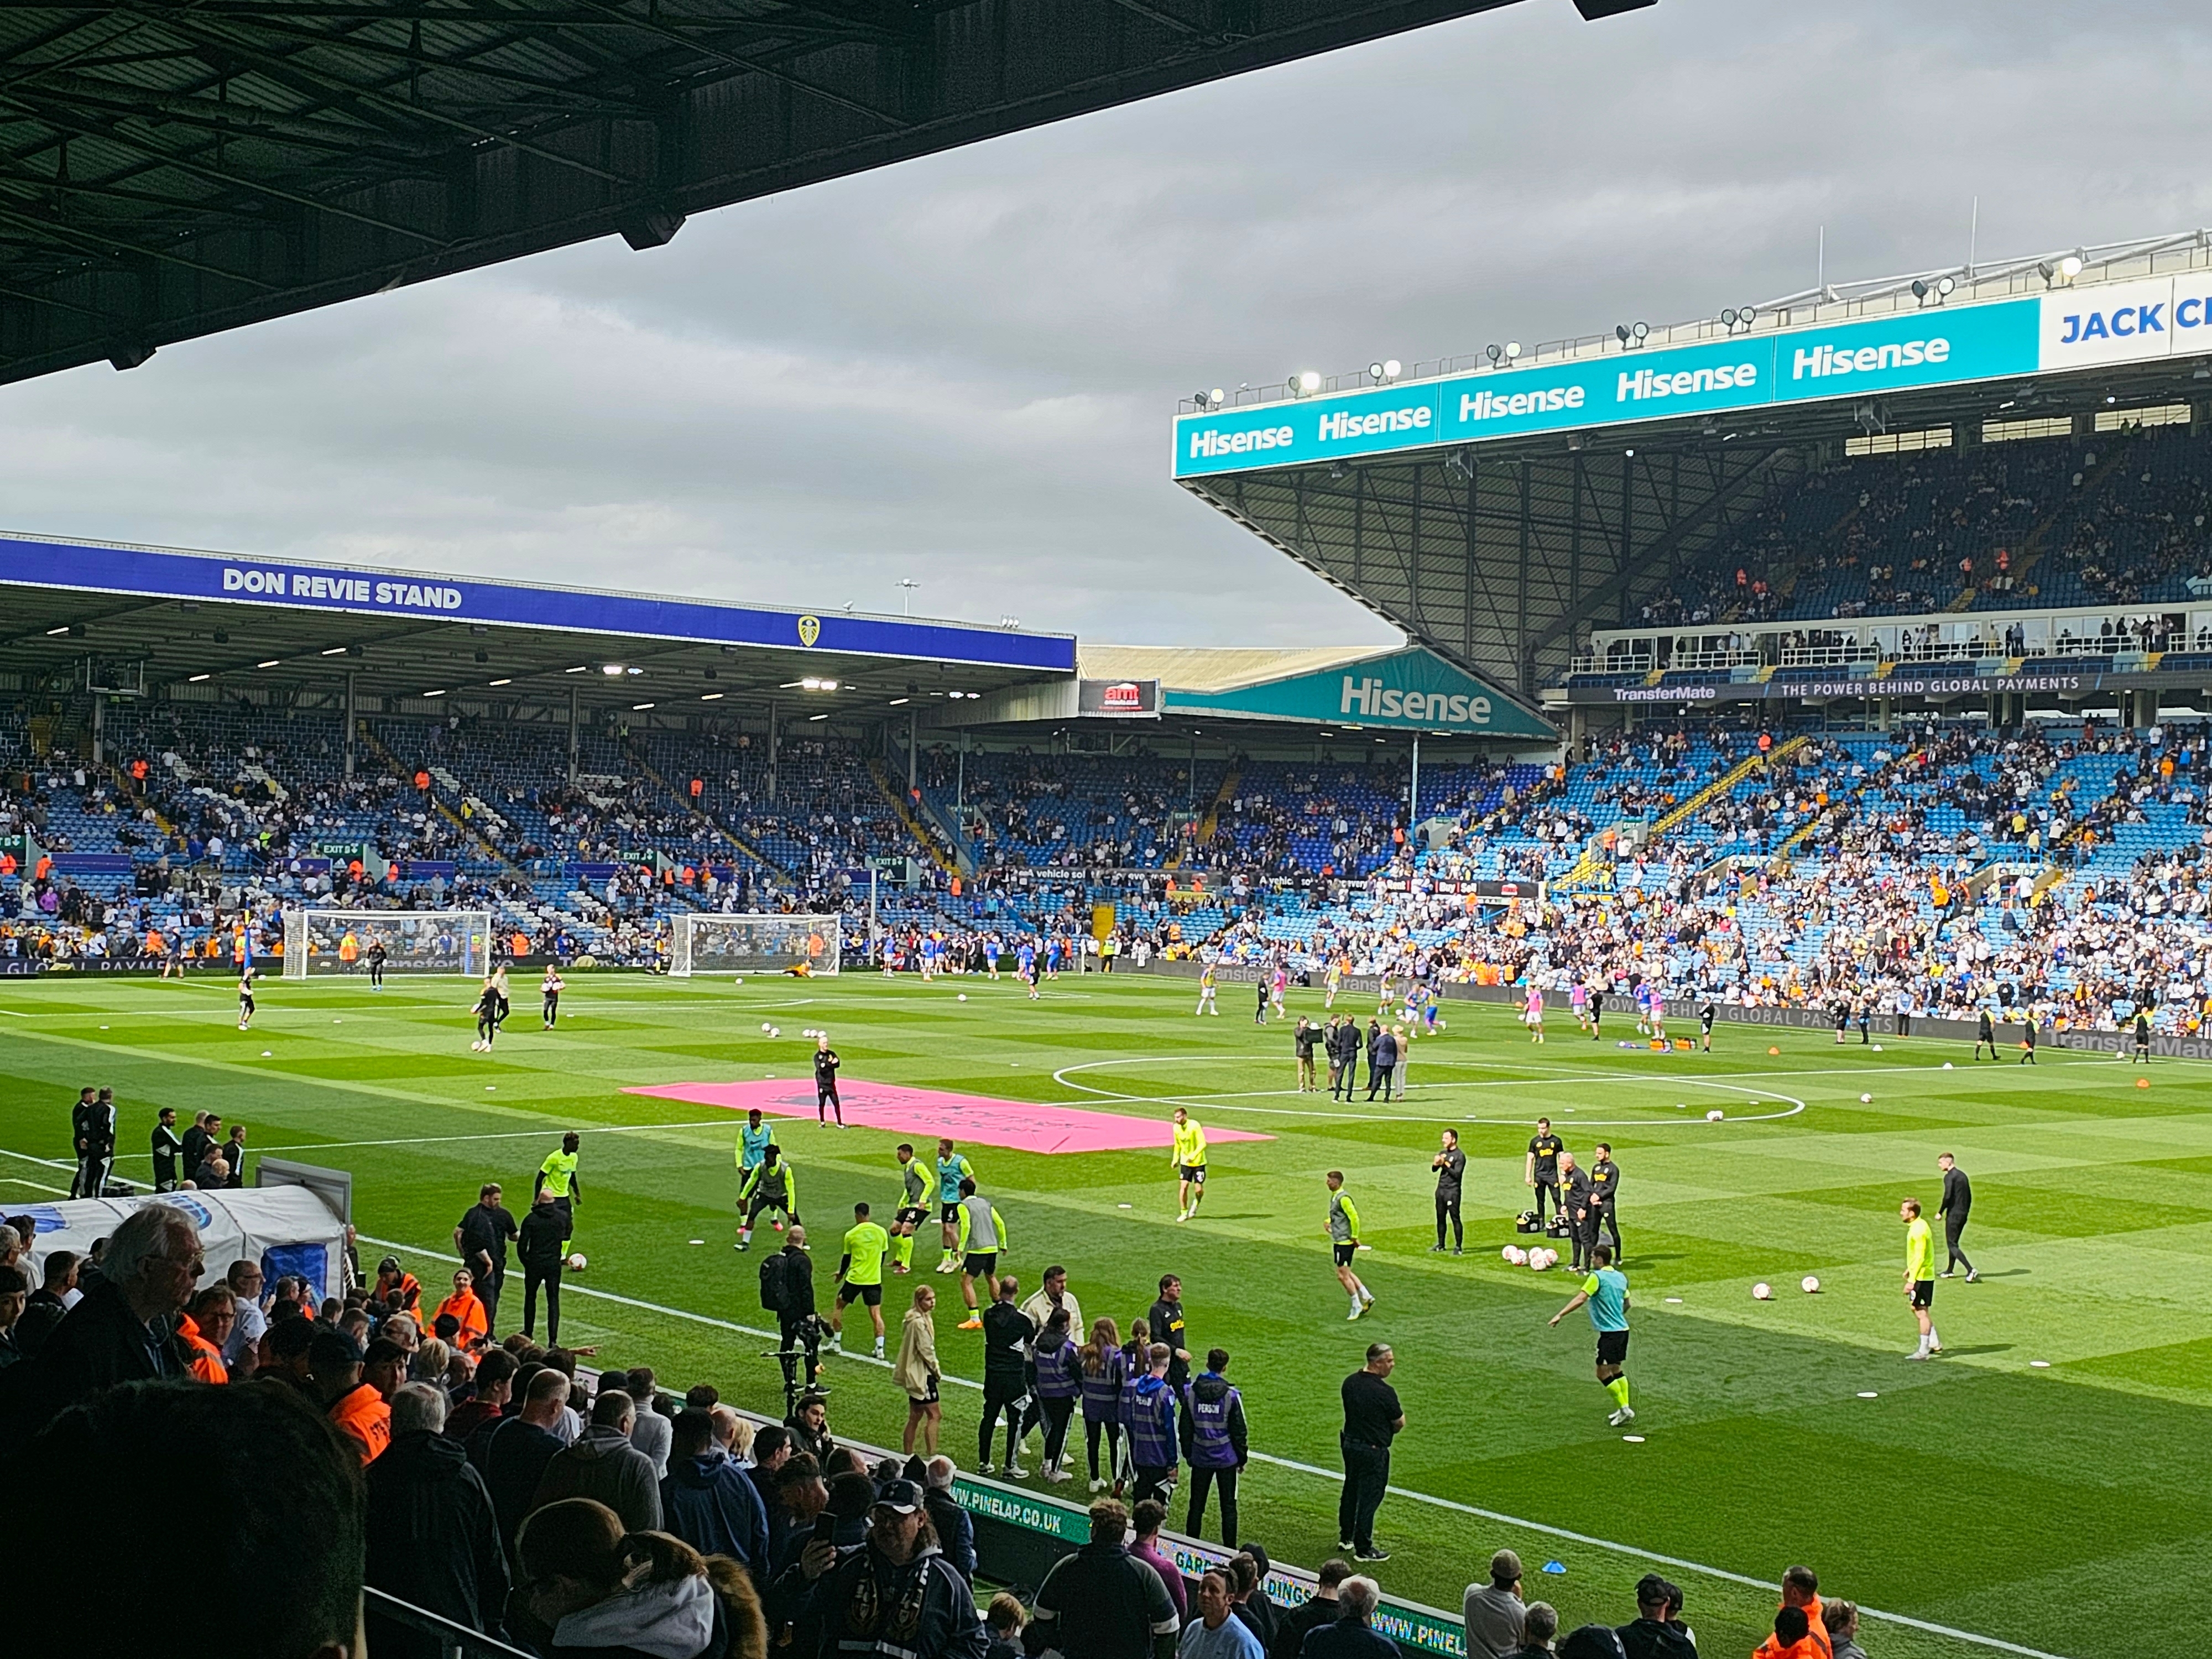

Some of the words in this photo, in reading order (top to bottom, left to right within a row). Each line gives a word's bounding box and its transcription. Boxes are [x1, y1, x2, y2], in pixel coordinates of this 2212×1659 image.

[2060, 303, 2165, 343] JACK
[1792, 337, 1950, 380] Hisense
[1617, 363, 1756, 402] Hisense
[1459, 384, 1584, 422] Hisense
[1190, 423, 1293, 458] Hisense
[1318, 405, 1431, 441] Hisense
[223, 568, 285, 595] DON
[293, 574, 371, 602] REVIE
[376, 582, 462, 609] STAND
[1340, 676, 1491, 724] Hisense
[1613, 686, 1715, 701] TransferMate
[1782, 684, 1807, 696] THE
[1814, 683, 1863, 696] POWER
[1869, 681, 1924, 693] BEHIND
[1931, 679, 1990, 692] GLOBAL
[1997, 677, 2079, 691] PAYMENTS
[324, 845, 343, 853] EXIT
[624, 852, 640, 860] EXIT
[1439, 882, 1456, 894] Buy
[1728, 1007, 1794, 1025] GLOBAL
